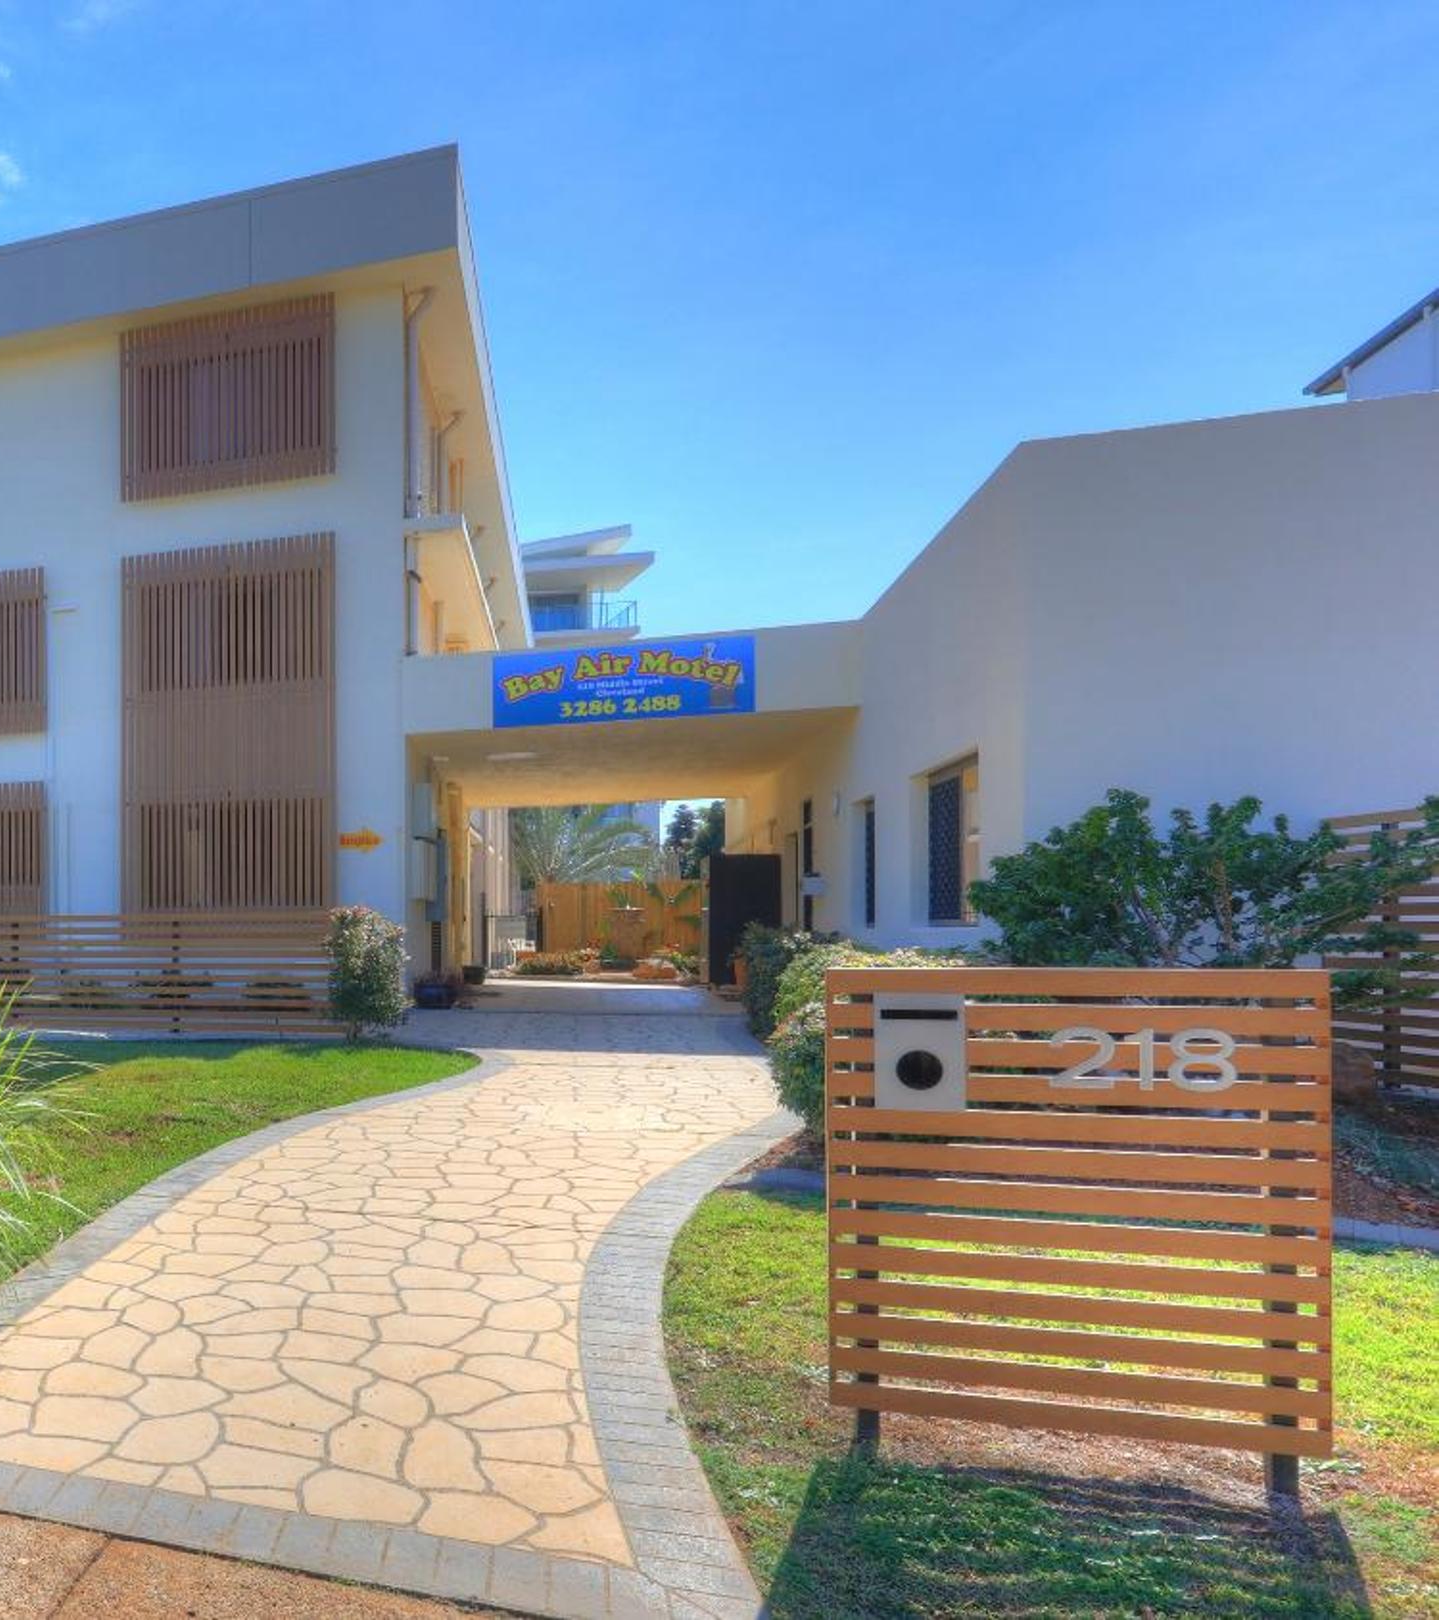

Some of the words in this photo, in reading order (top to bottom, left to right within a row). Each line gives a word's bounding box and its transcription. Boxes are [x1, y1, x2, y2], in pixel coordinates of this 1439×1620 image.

[502, 666, 564, 701] Bay
[572, 652, 632, 681] Air
[637, 650, 743, 688] Motel
[560, 698, 616, 717] 3286
[623, 694, 681, 714] 2488
[1048, 1026, 1239, 1093] 218
